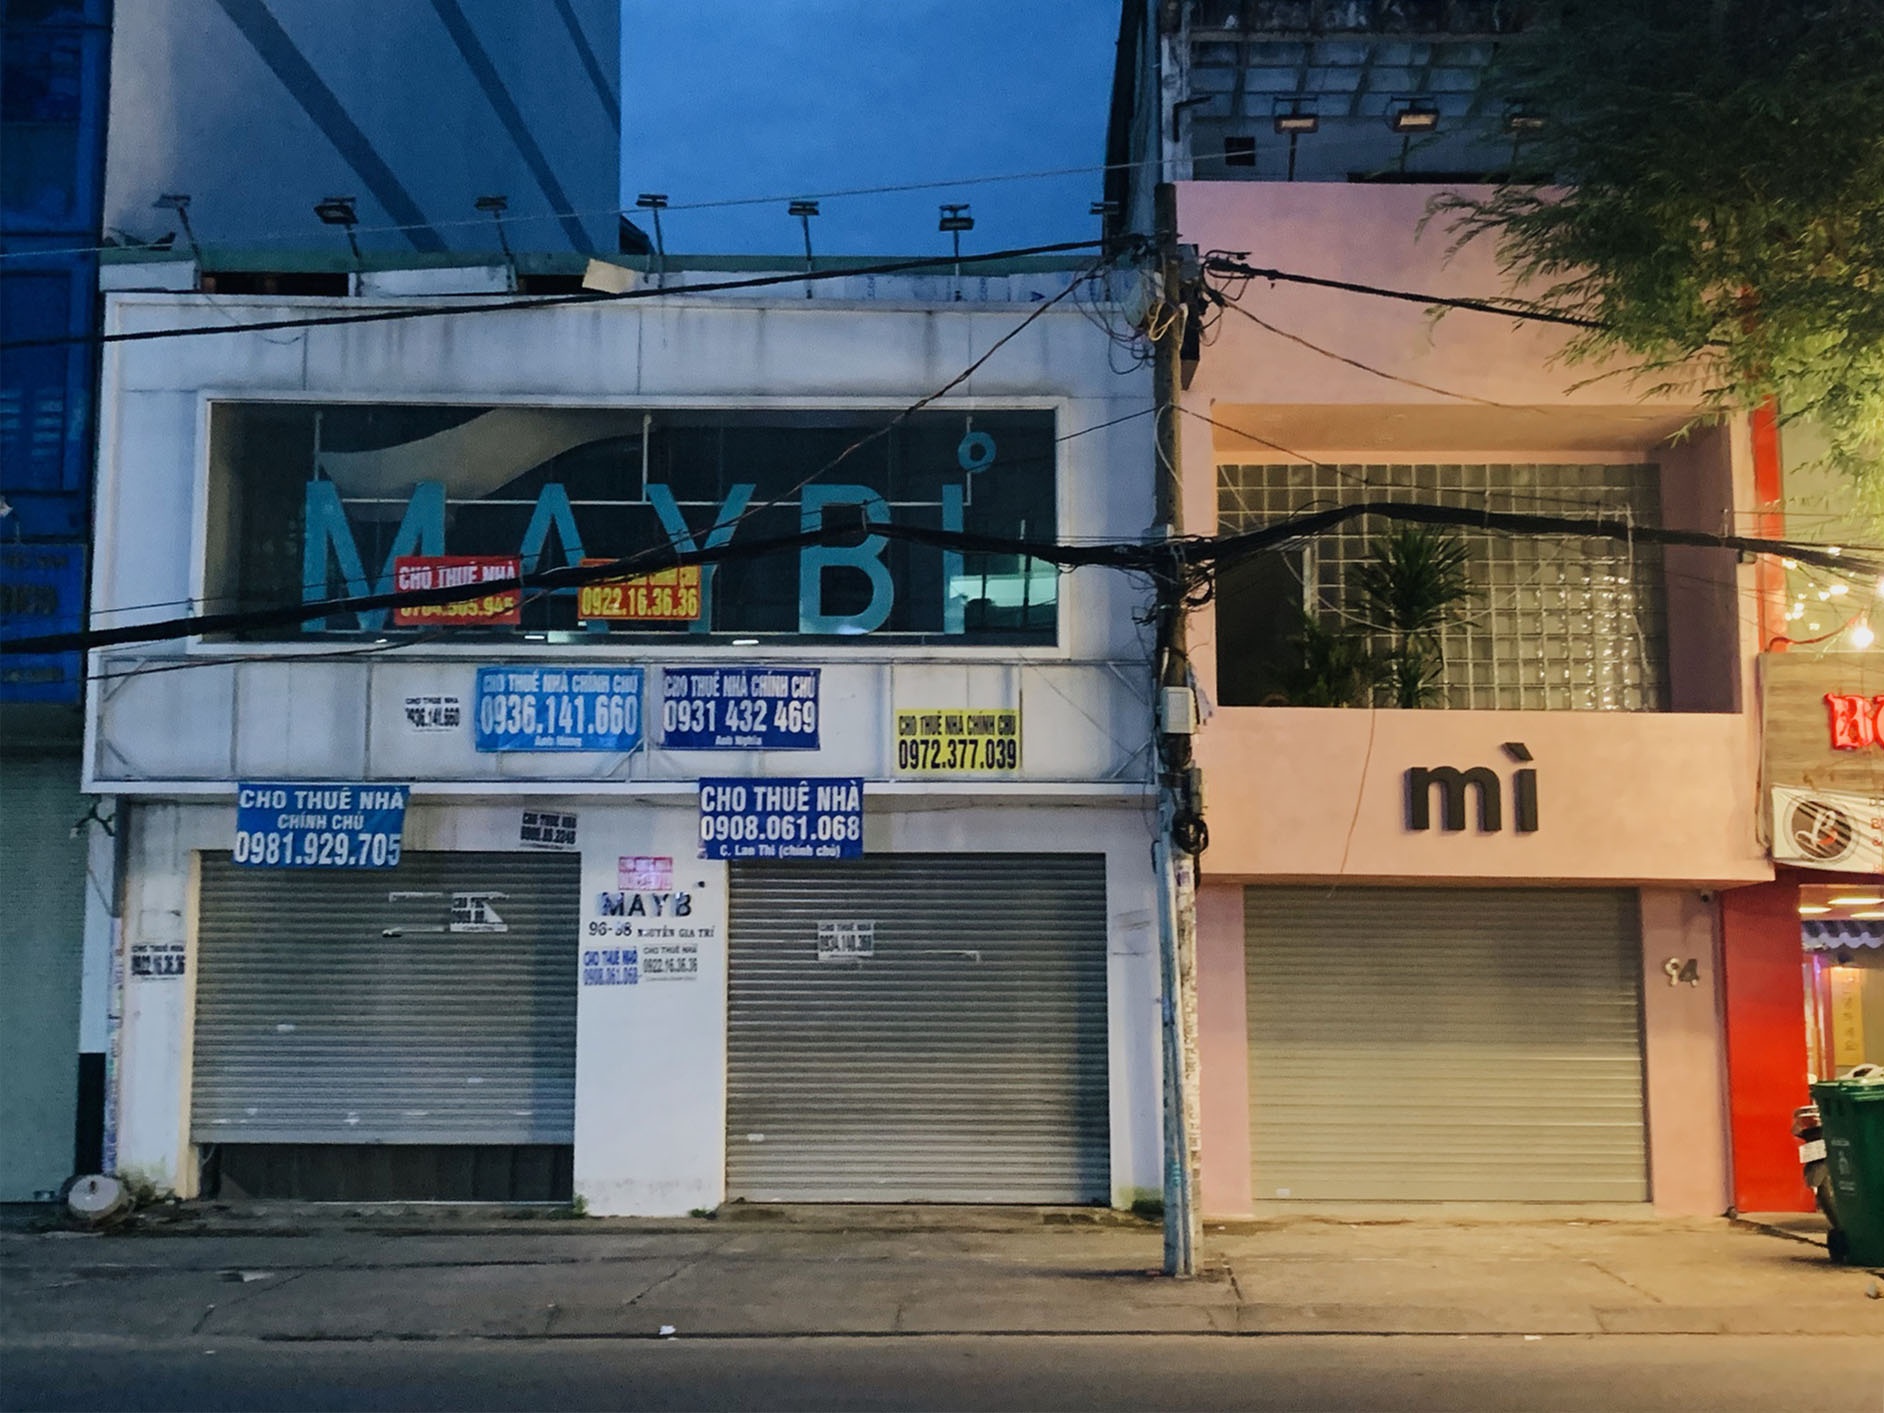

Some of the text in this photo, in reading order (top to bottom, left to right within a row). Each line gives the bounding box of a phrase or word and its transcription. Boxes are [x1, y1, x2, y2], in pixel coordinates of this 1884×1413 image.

[582, 587, 698, 617] 0922.16.36.36
[664, 670, 816, 699] CHO THUÊ NHÀ CHÍNH CHỦ
[480, 694, 638, 735] 0936.141.660
[664, 700, 816, 733] 0931 432 469
[898, 715, 917, 736] CHO
[898, 739, 1018, 769] 0972.377.039
[239, 787, 405, 811] CHO THUÊ NHÀ
[701, 780, 860, 813] CHO THUÊ NHÀ
[1403, 741, 1539, 832] mì
[277, 811, 365, 831] CHÍNH CHỦ
[701, 815, 860, 841] 0908.061.068
[233, 831, 402, 866] 0981.929.705
[1664, 957, 1700, 988] 94
